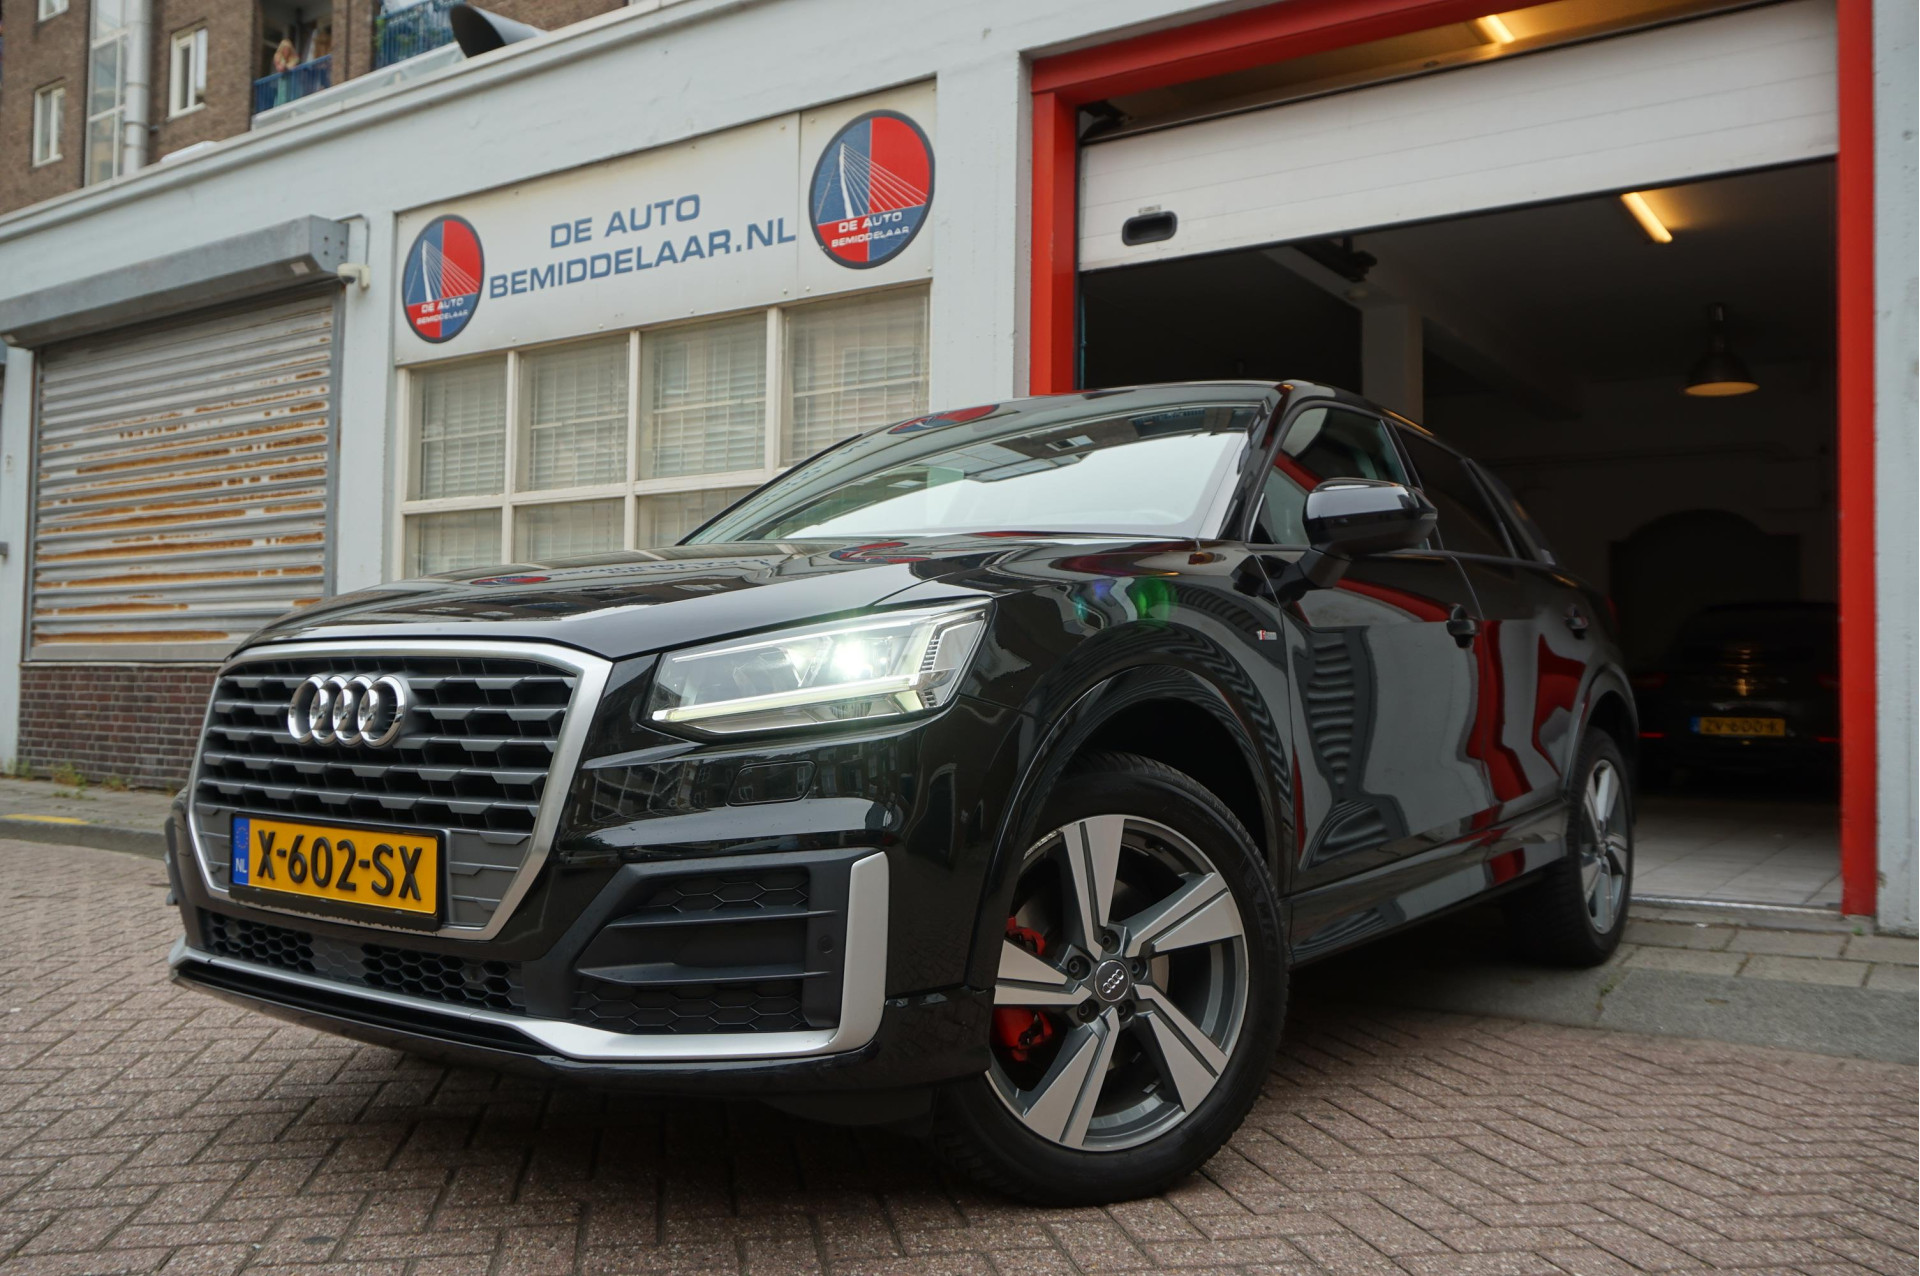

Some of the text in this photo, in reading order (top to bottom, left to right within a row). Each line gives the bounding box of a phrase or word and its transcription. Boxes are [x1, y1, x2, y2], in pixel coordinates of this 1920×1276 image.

[550, 194, 700, 248] DE AUTO
[838, 212, 902, 233] DE AUTO
[831, 226, 910, 248] BEMIDDELAAR
[489, 217, 796, 299] BEMIDDELAAR.NL
[421, 297, 464, 314] DE AUTO
[235, 857, 247, 874] NL
[257, 829, 423, 901] X-602-SX
